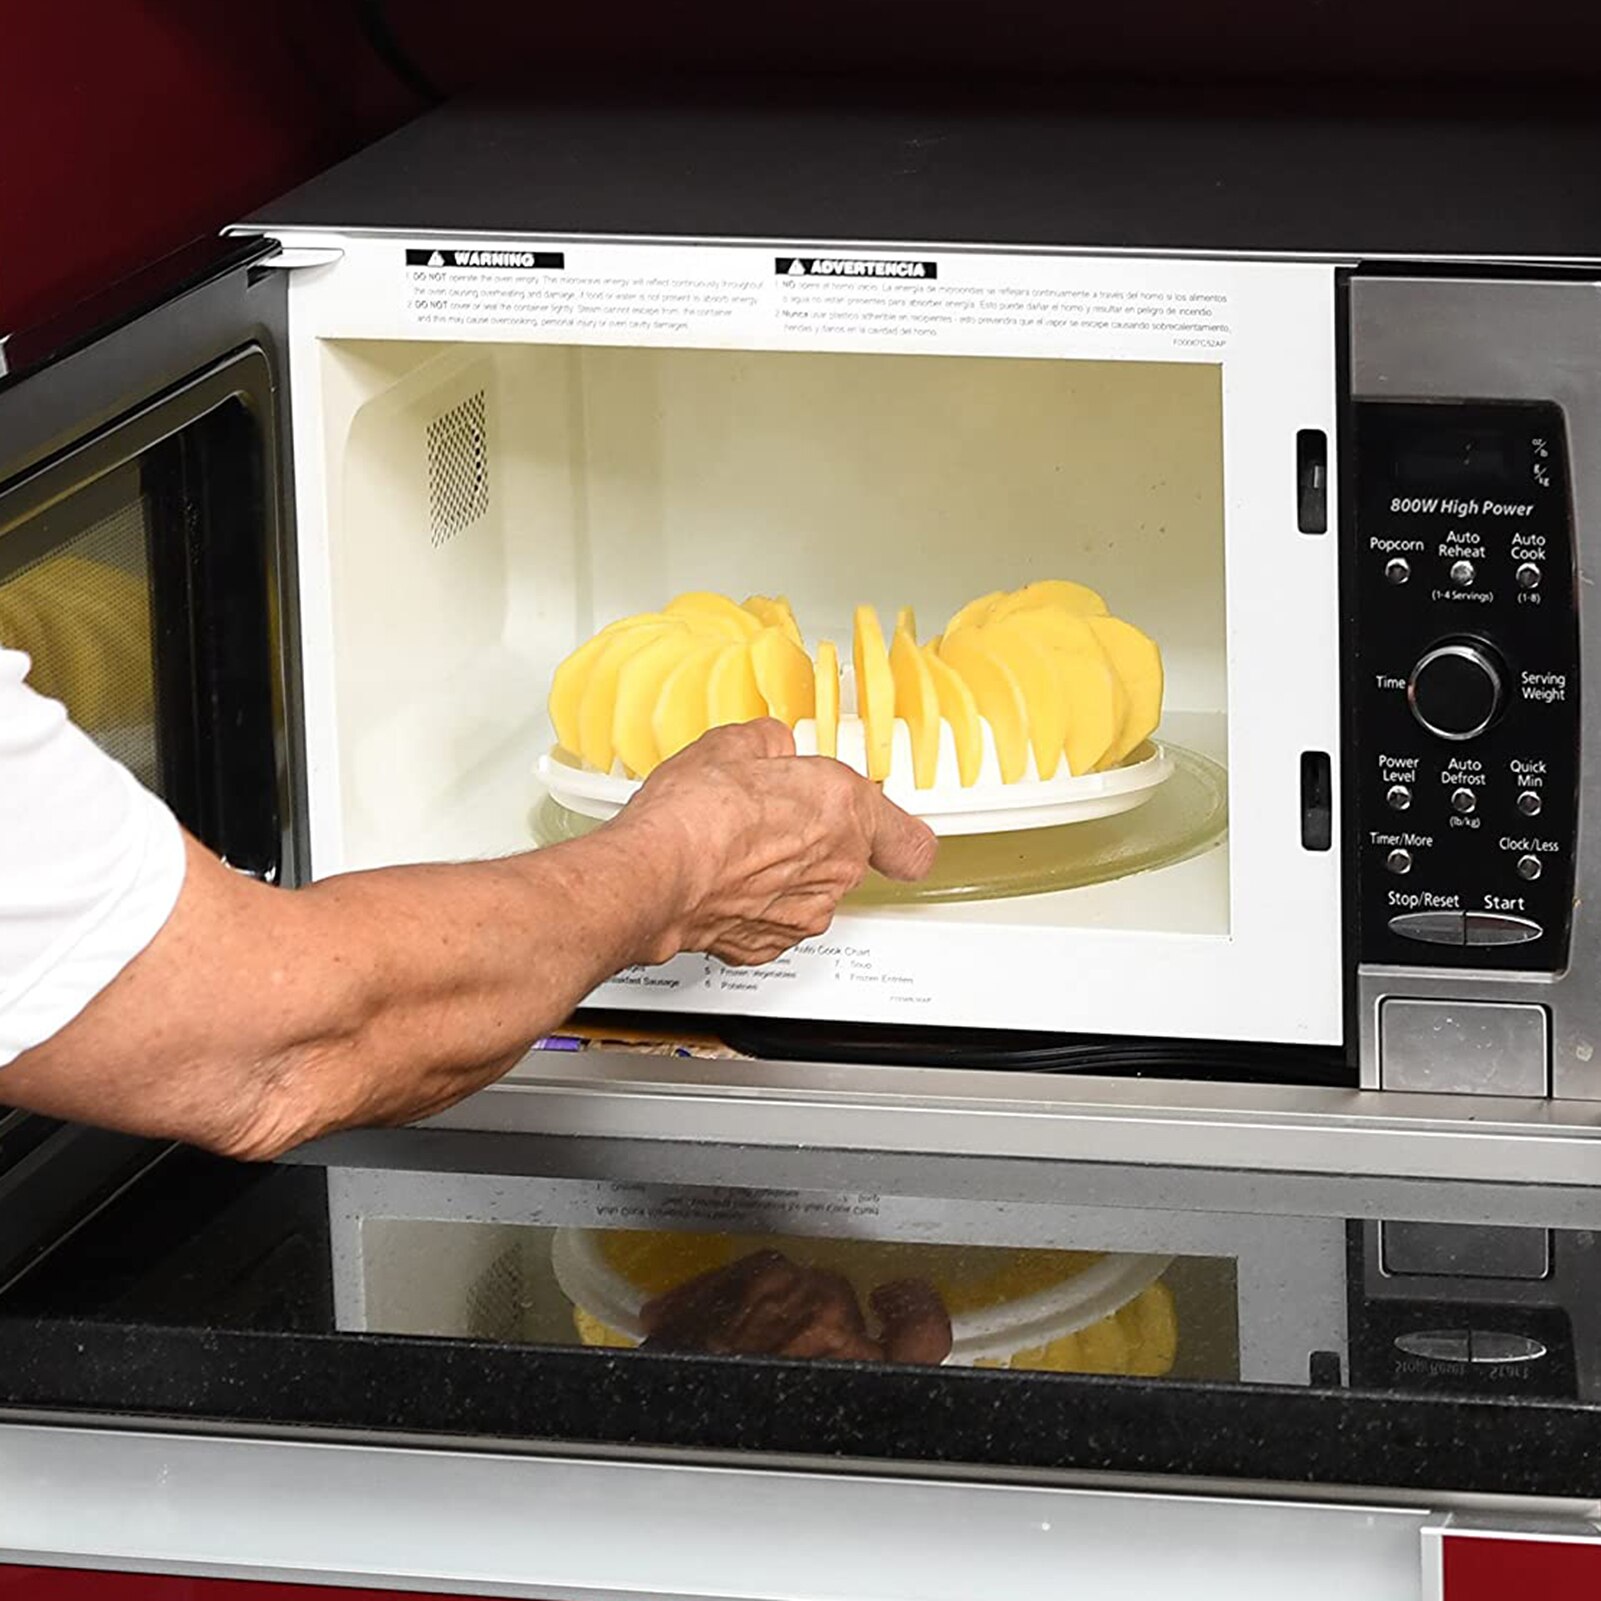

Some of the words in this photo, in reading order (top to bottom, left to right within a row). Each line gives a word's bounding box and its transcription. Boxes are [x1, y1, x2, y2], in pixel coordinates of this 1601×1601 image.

[455, 252, 535, 267] WARNING
[811, 259, 925, 276] ADVERTENCIA
[413, 272, 427, 282] DO
[428, 272, 447, 282] NOT
[415, 300, 428, 309] DO
[430, 300, 448, 310] NOT
[1189, 293, 1227, 303] alimentos
[1390, 498, 1438, 513] 800W
[1440, 499, 1479, 518] High
[1481, 501, 1534, 516] Power
[1370, 537, 1425, 552] Popcorn
[1446, 531, 1481, 545] Auto
[1511, 533, 1546, 546] Auto
[1438, 544, 1486, 558] Reheat
[1510, 547, 1546, 561] Cook
[1432, 590, 1450, 601] (1-4
[1451, 590, 1494, 603] Servings)
[1517, 593, 1541, 604] (1-8)
[1376, 675, 1406, 689] Time
[1521, 671, 1566, 688] Serving
[1521, 687, 1566, 703] Weight
[1378, 755, 1419, 769] Power
[1448, 758, 1482, 771] Auto
[1510, 759, 1547, 775] Quick
[1382, 769, 1416, 783] Level
[1441, 771, 1486, 785] Defrost
[1517, 775, 1543, 787] Min
[1449, 815, 1481, 829] (lb/kg)
[1370, 832, 1433, 847] Timer/More
[1499, 837, 1559, 852] Clock/Less
[1388, 891, 1460, 909] Stop/Reset
[1484, 895, 1525, 910] Start
[844, 946, 871, 957] Chart
[643, 977, 680, 989] Sausage
[850, 973, 879, 982] Frozen
